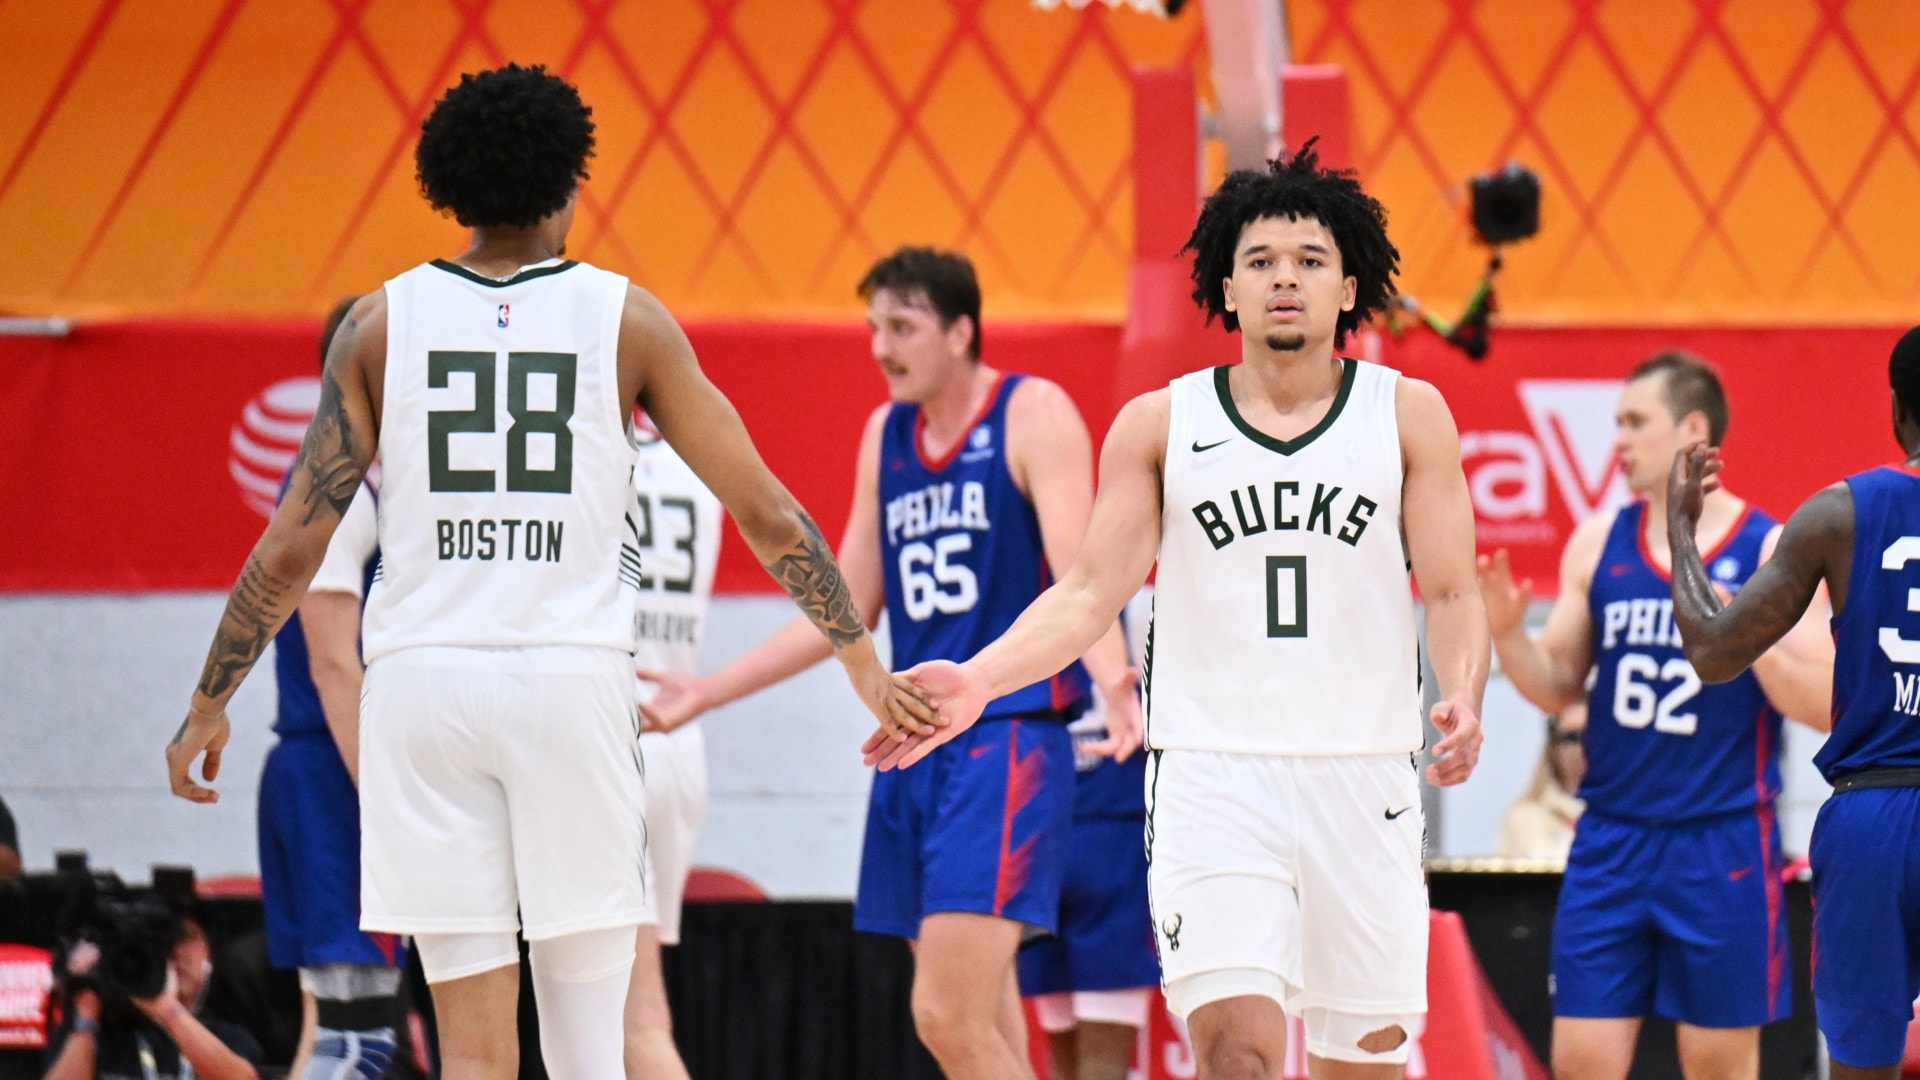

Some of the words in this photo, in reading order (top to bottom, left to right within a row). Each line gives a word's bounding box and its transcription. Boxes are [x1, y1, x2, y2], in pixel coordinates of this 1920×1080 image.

[427, 350, 578, 494] 28
[436, 519, 563, 563] BOSTON
[886, 481, 991, 546] PHILA
[1191, 481, 1378, 550] BUCKS
[899, 532, 979, 622] 65
[1265, 555, 1308, 638] 0
[1613, 652, 1702, 735] 62
